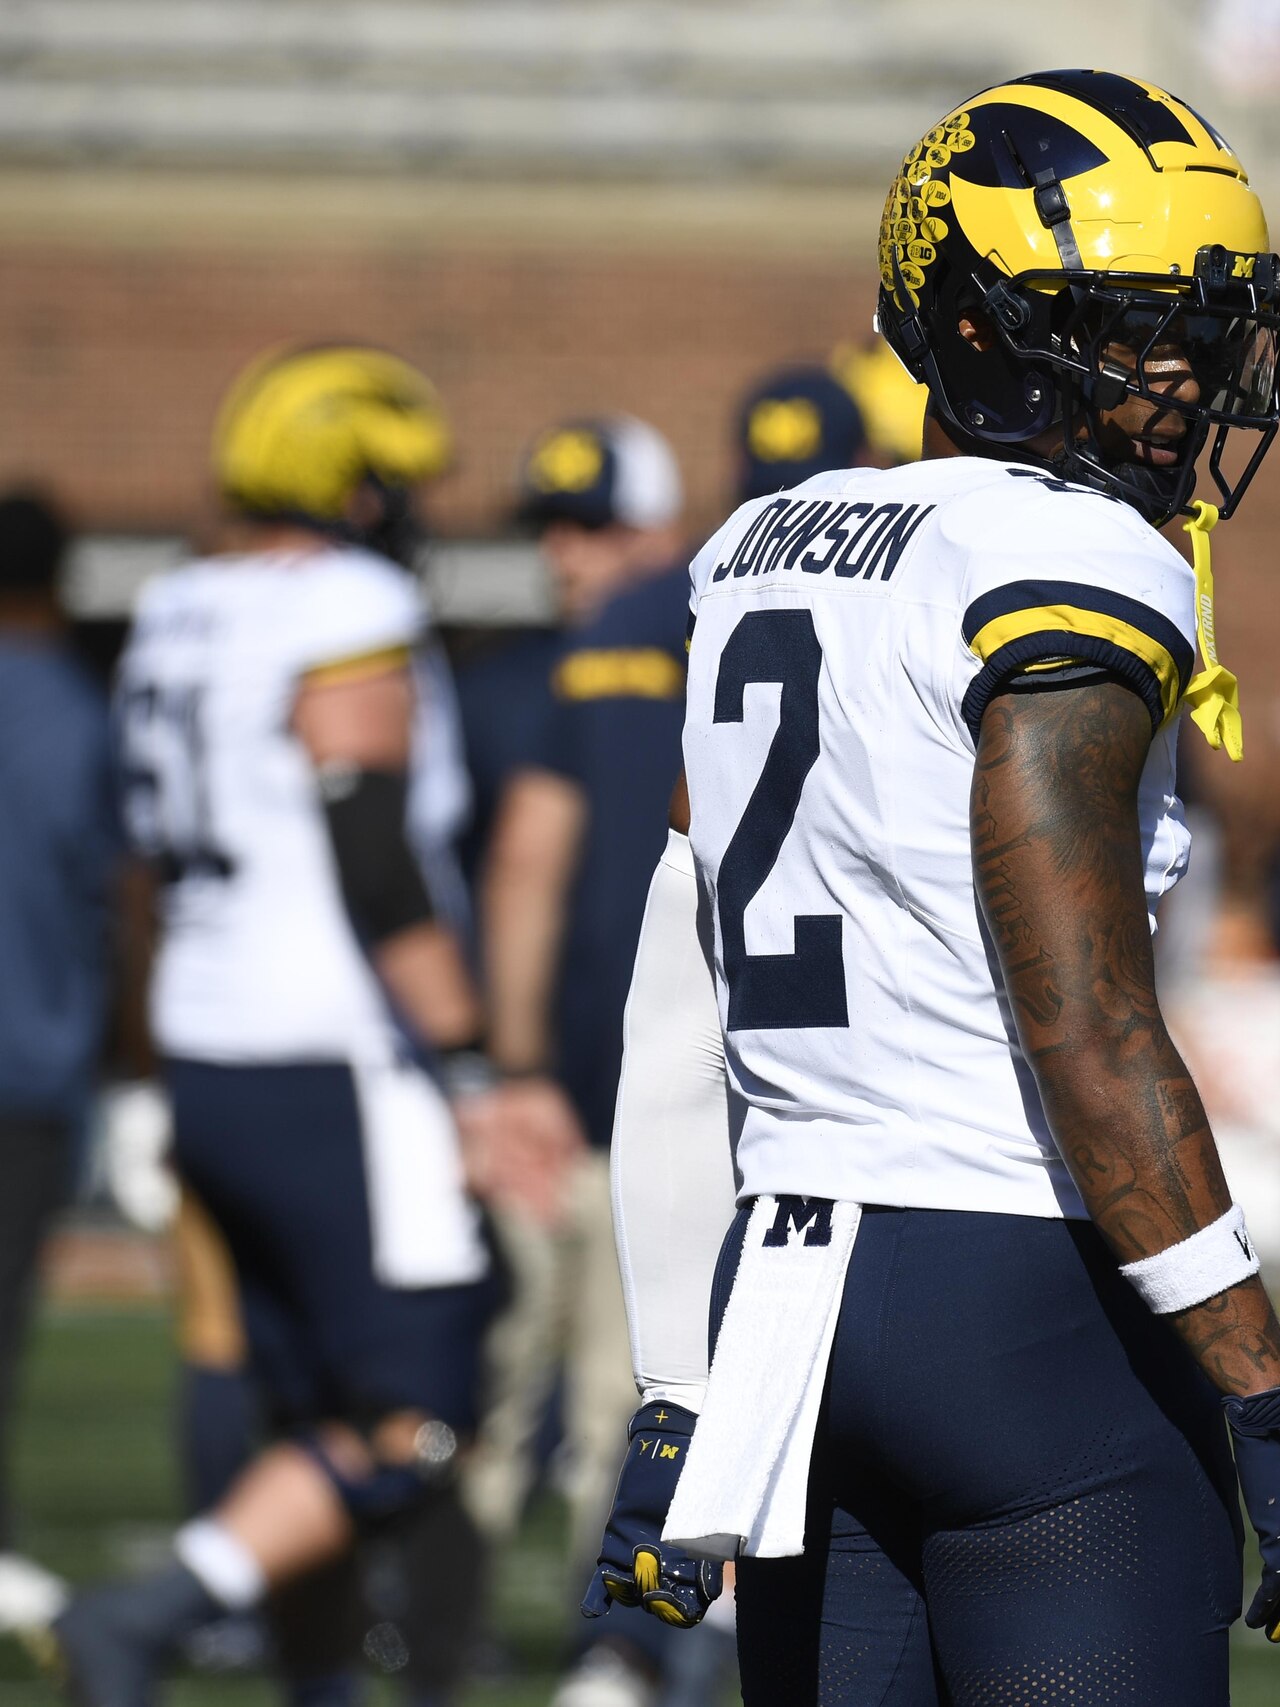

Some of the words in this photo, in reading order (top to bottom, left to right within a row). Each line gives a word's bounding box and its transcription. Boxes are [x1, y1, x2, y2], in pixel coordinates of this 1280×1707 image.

[1232, 255, 1255, 278] M
[713, 497, 936, 583] JOHNSON
[1200, 593, 1218, 665] NXTRND
[713, 608, 850, 1031] 2
[762, 1193, 838, 1247] M
